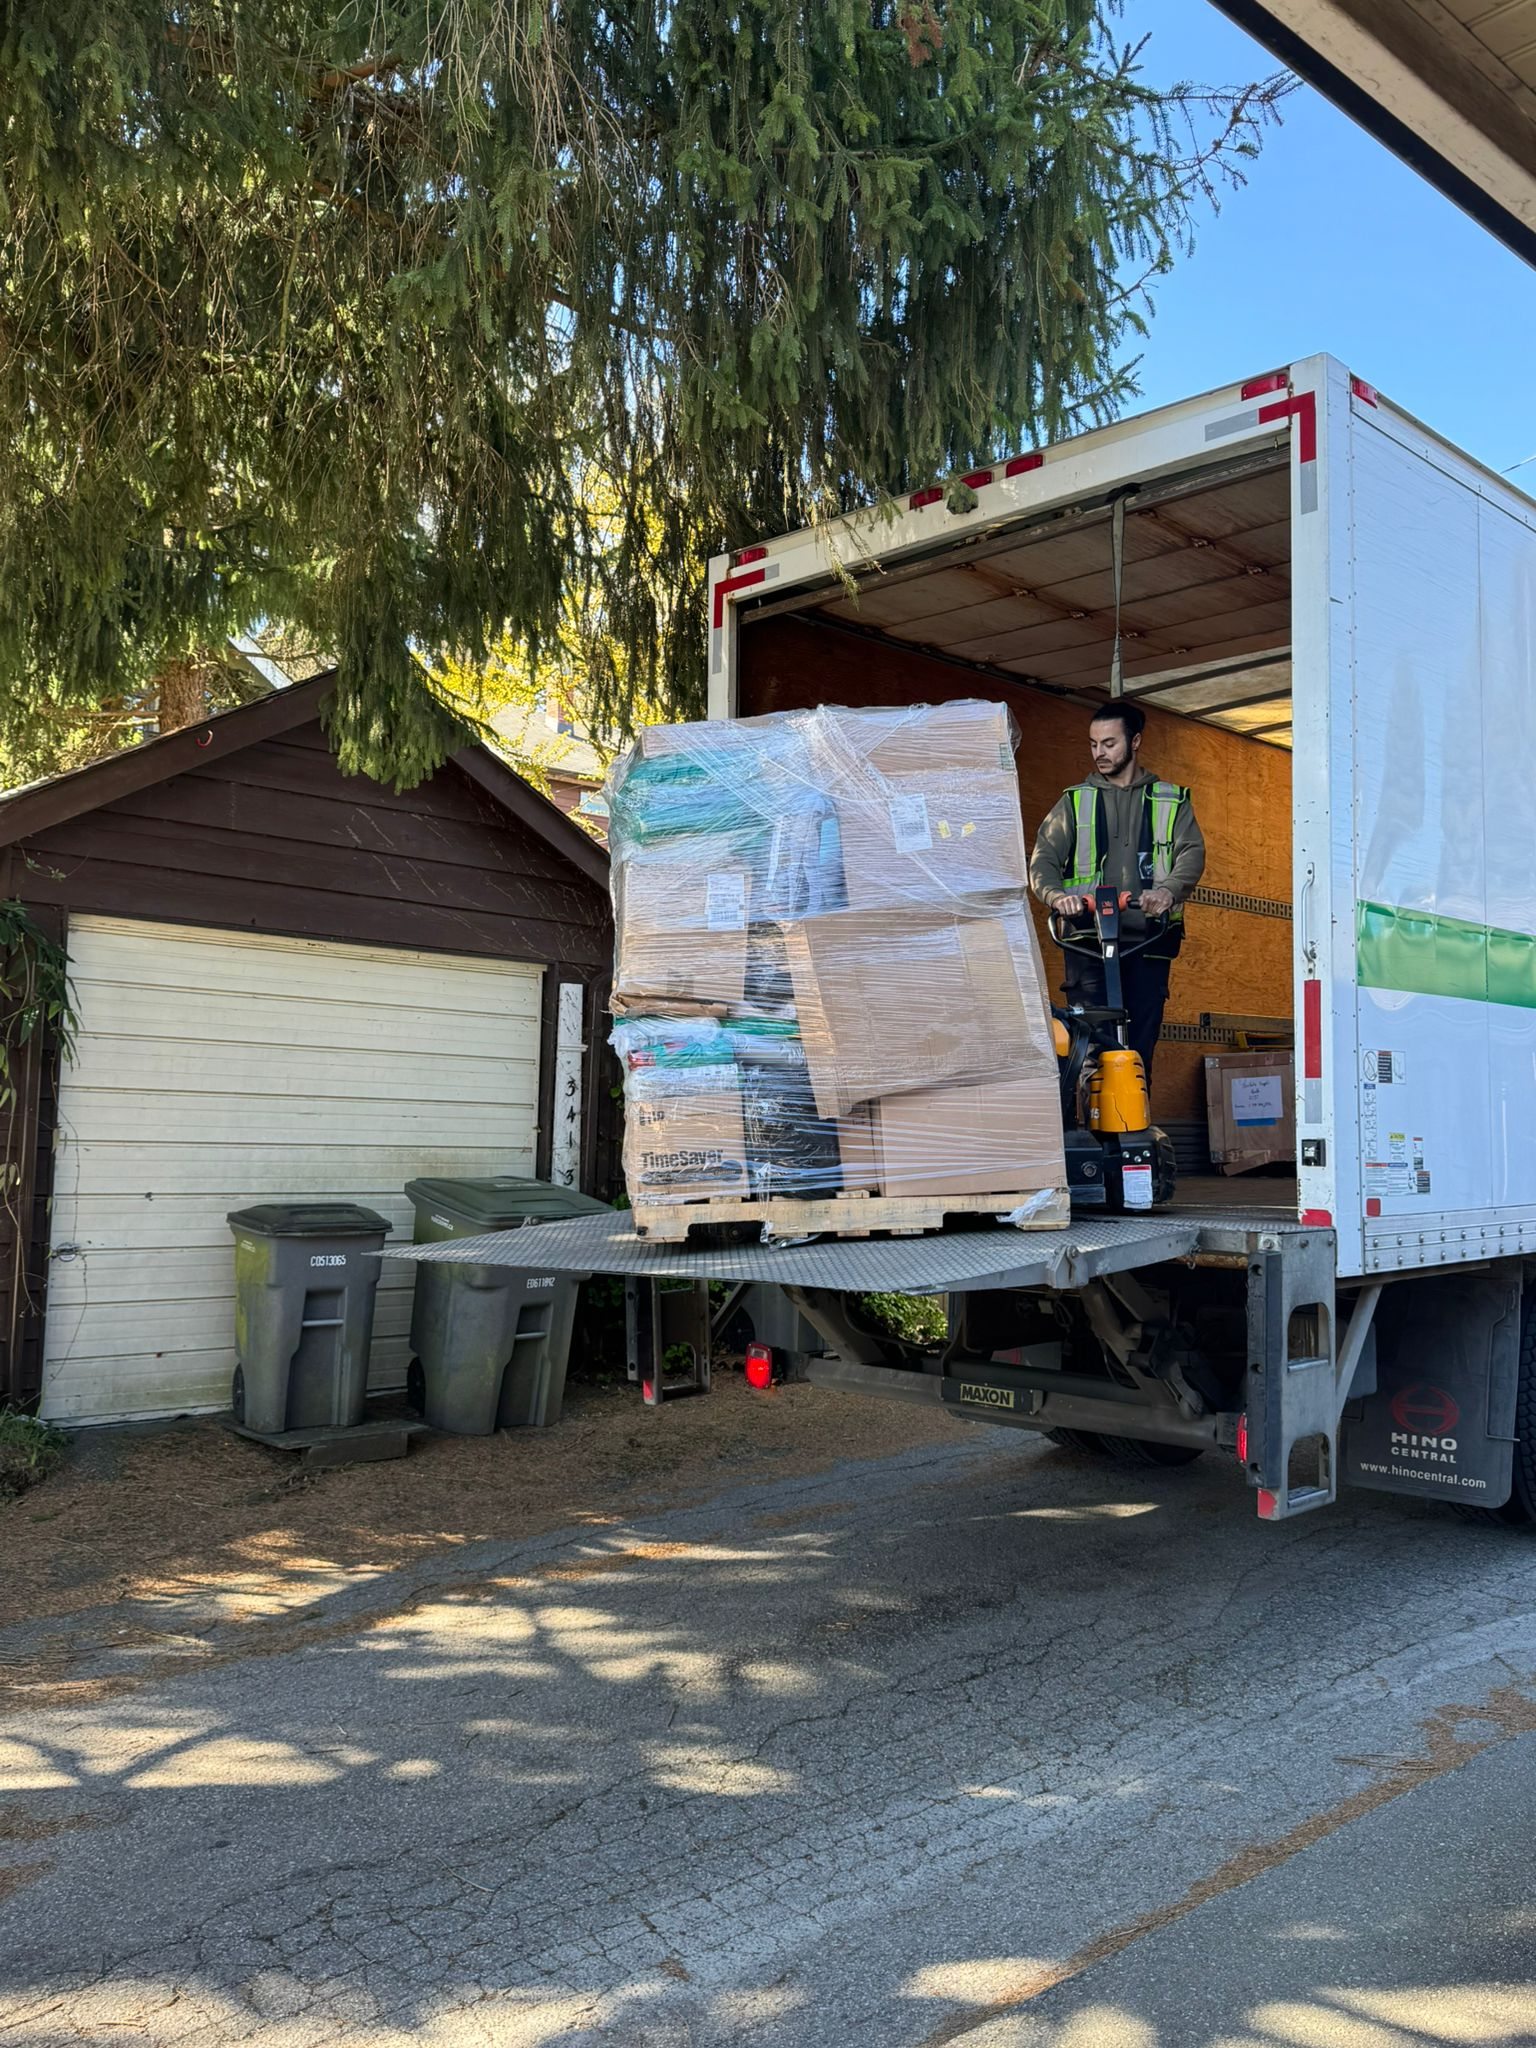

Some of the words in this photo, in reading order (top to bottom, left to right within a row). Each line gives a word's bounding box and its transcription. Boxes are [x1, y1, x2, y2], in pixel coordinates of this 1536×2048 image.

[563, 1078, 577, 1186] 3413
[640, 1149, 723, 1169] TimeSaver
[962, 1385, 1010, 1405] MAXON
[1391, 1432, 1458, 1451] HINO
[1391, 1446, 1457, 1464] CENTRAL
[1360, 1461, 1487, 1489] www.hinocentral.com
